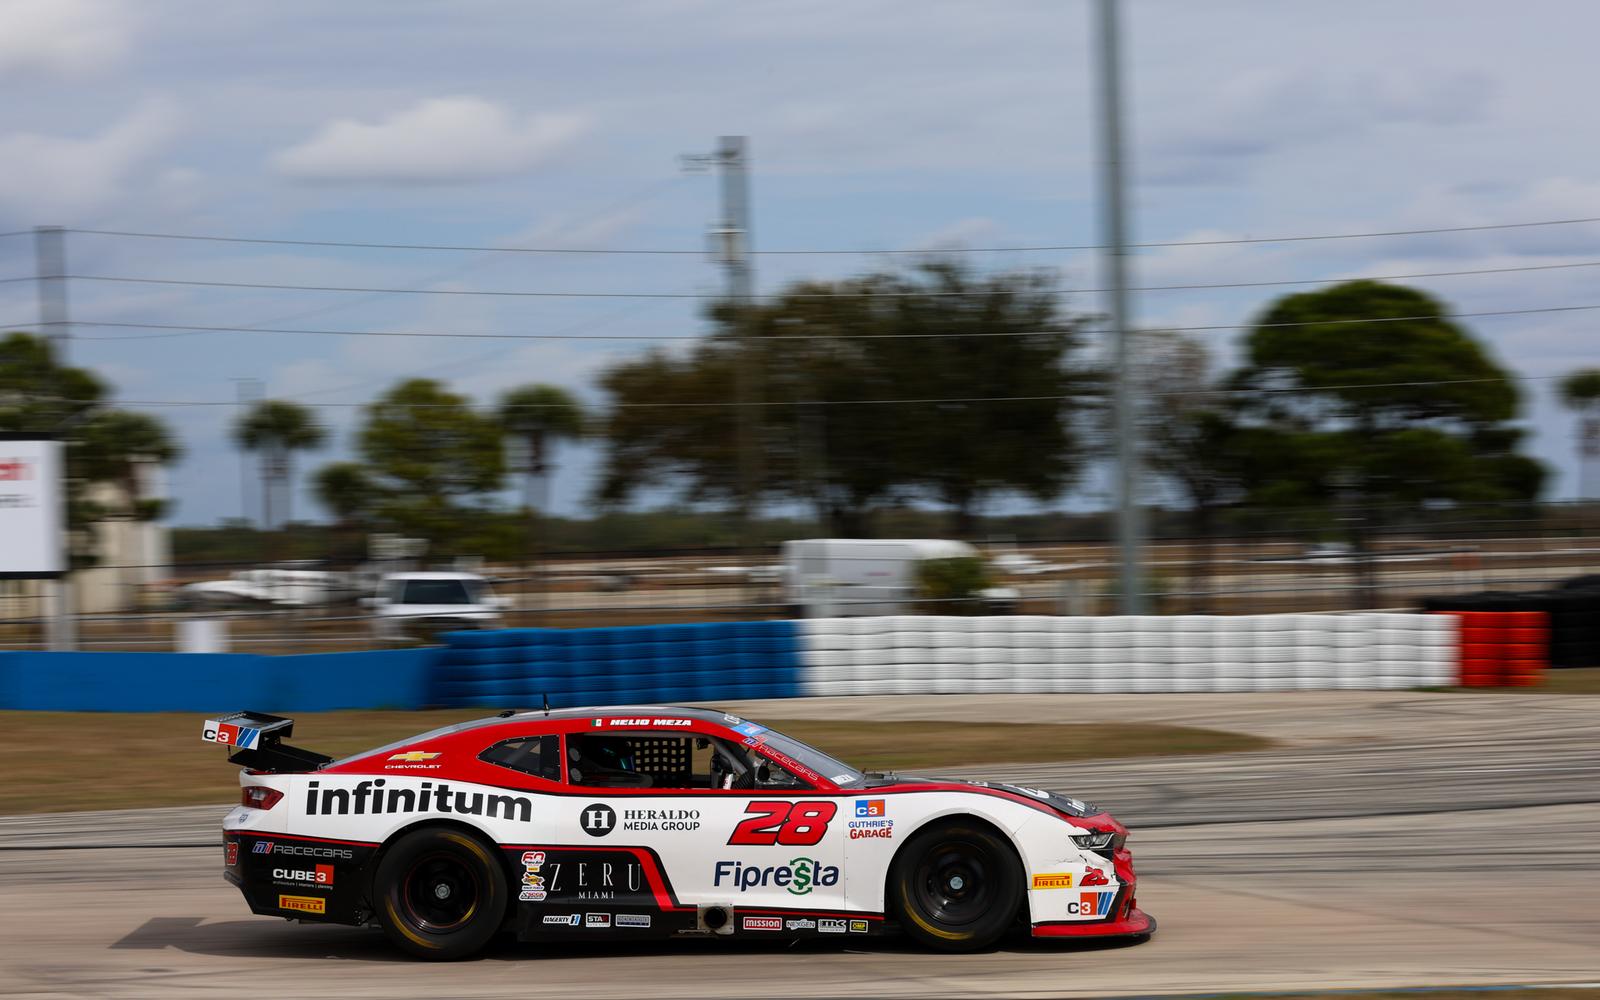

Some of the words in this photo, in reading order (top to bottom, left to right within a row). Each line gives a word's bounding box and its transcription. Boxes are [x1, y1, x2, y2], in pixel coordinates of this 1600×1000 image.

[203, 729, 230, 743] C3
[306, 779, 532, 822] infinitum
[624, 810, 701, 820] HERALDO
[856, 807, 879, 816] C3
[586, 810, 611, 829] H
[623, 821, 659, 831] MEDIA
[661, 821, 701, 831] GROUP
[727, 800, 838, 846] 28
[848, 819, 894, 829] GUTHRIE'S
[849, 827, 893, 840] GARAGE
[272, 868, 327, 882] CUBE3
[549, 863, 641, 892] ZERU
[1033, 875, 1070, 887] PIRELLI
[578, 891, 615, 899] MIAMI
[281, 897, 324, 911] PIRELLI
[1067, 901, 1092, 915] C3
